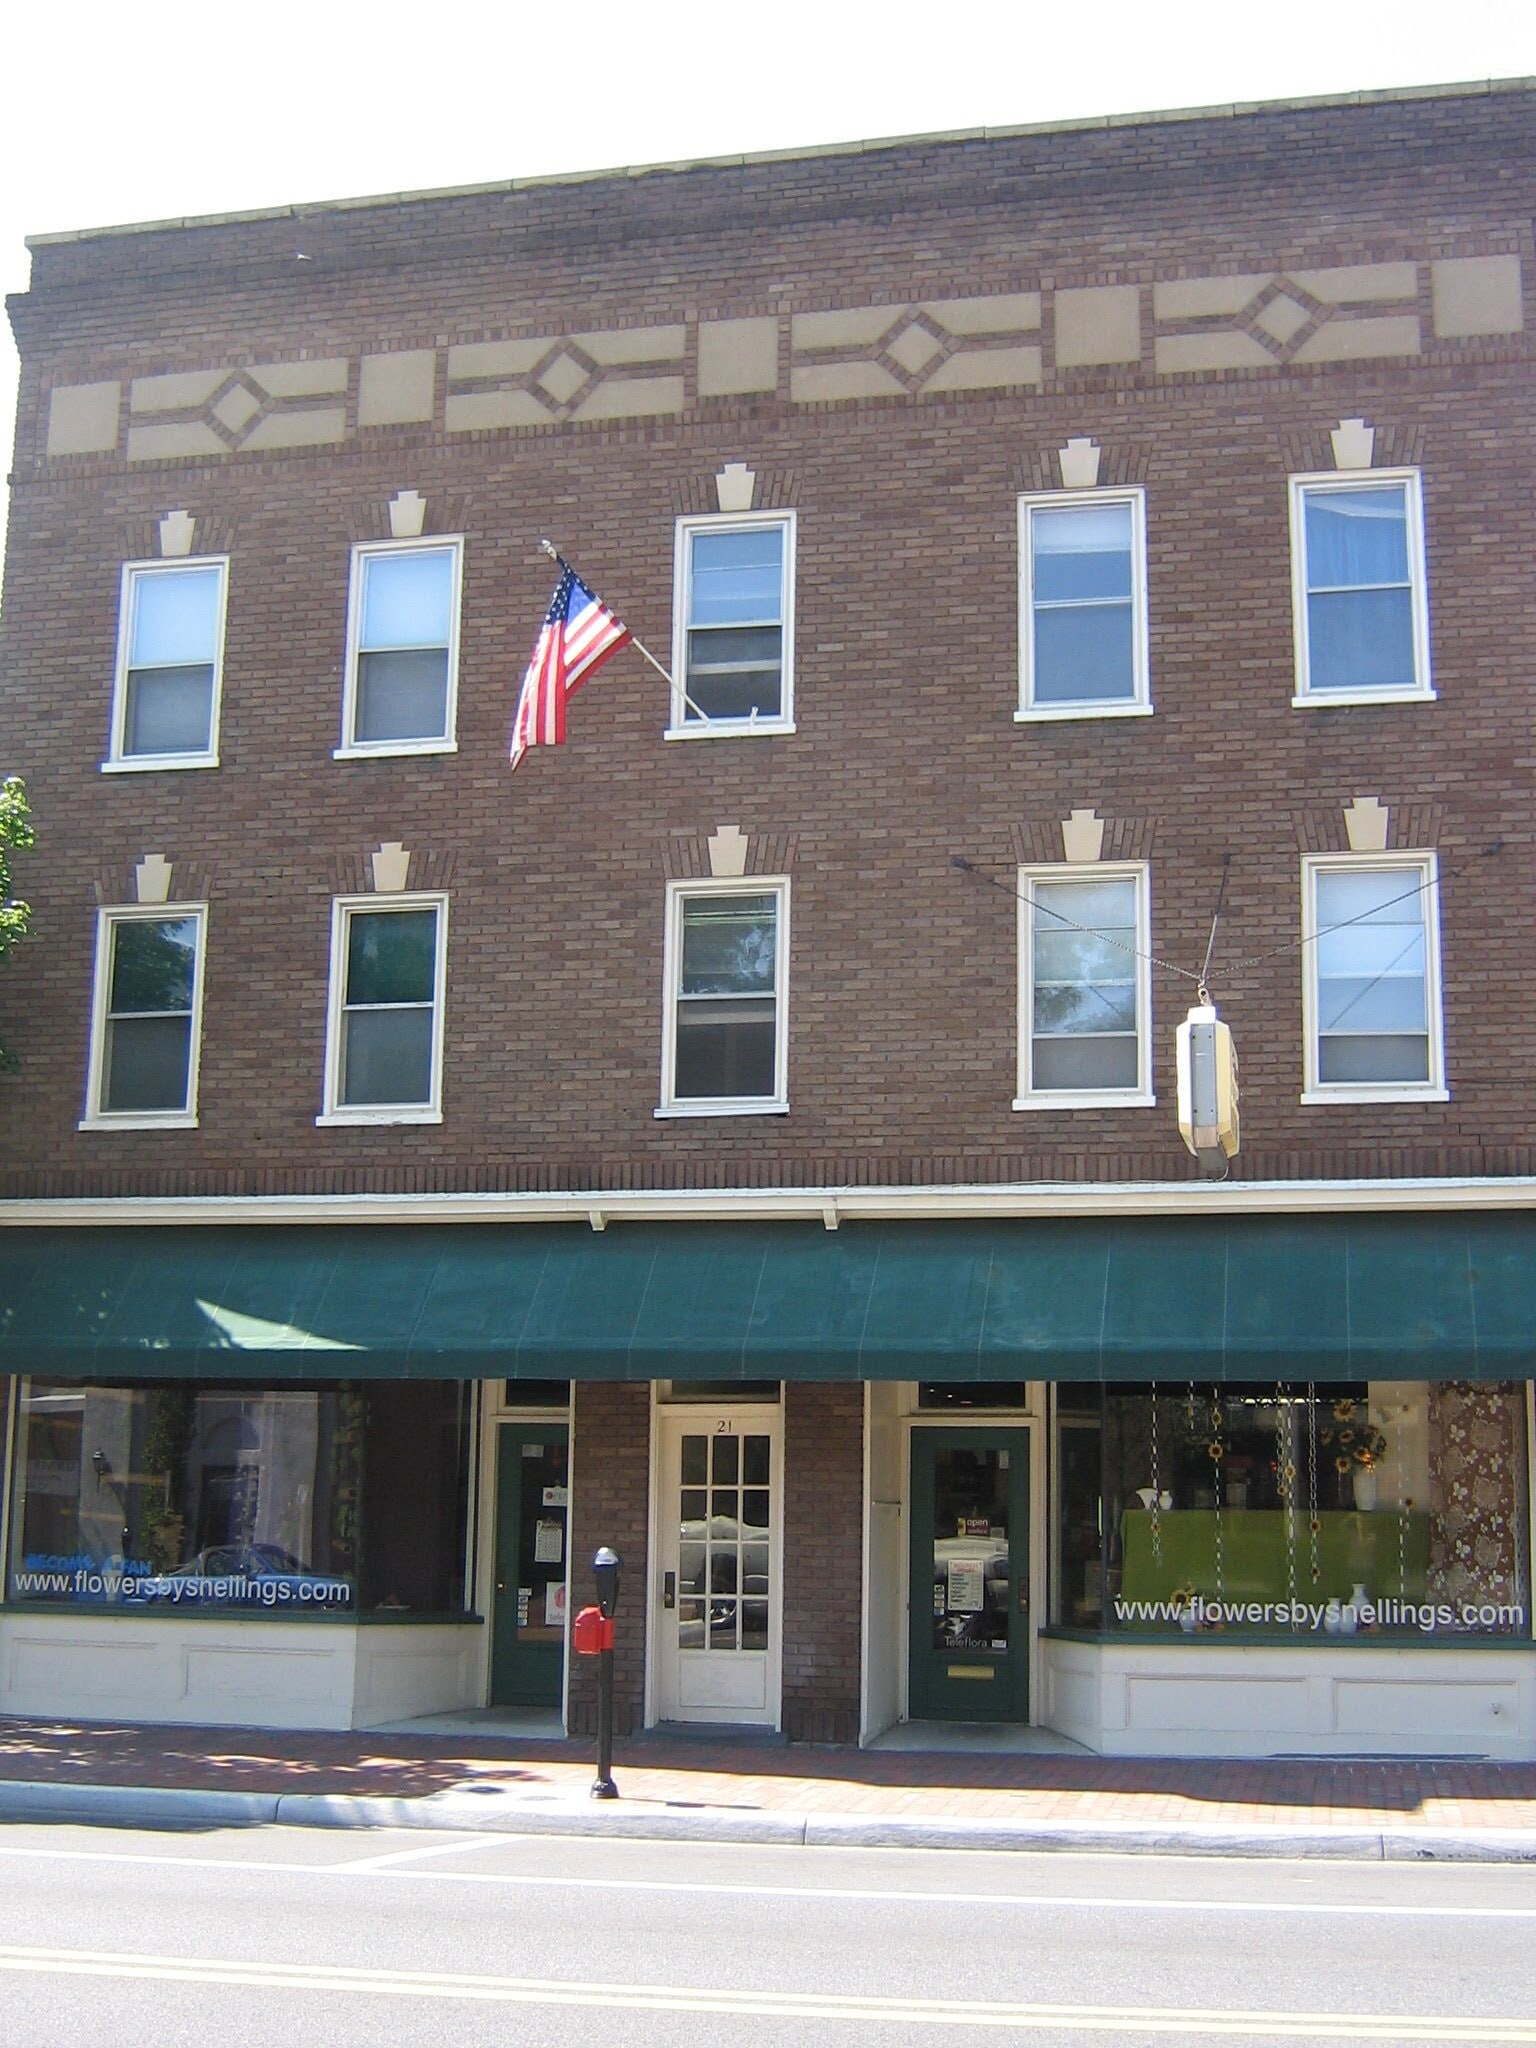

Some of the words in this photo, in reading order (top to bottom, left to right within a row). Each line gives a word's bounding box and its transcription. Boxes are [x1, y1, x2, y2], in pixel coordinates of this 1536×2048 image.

[717, 1420, 732, 1432] 21
[966, 1519, 988, 1527] open
[14, 1569, 351, 1605] www.flowersbysnellings.com
[1113, 1596, 1525, 1631] www.flowersbysnellings.com
[944, 1635, 988, 1649] Teleflora
